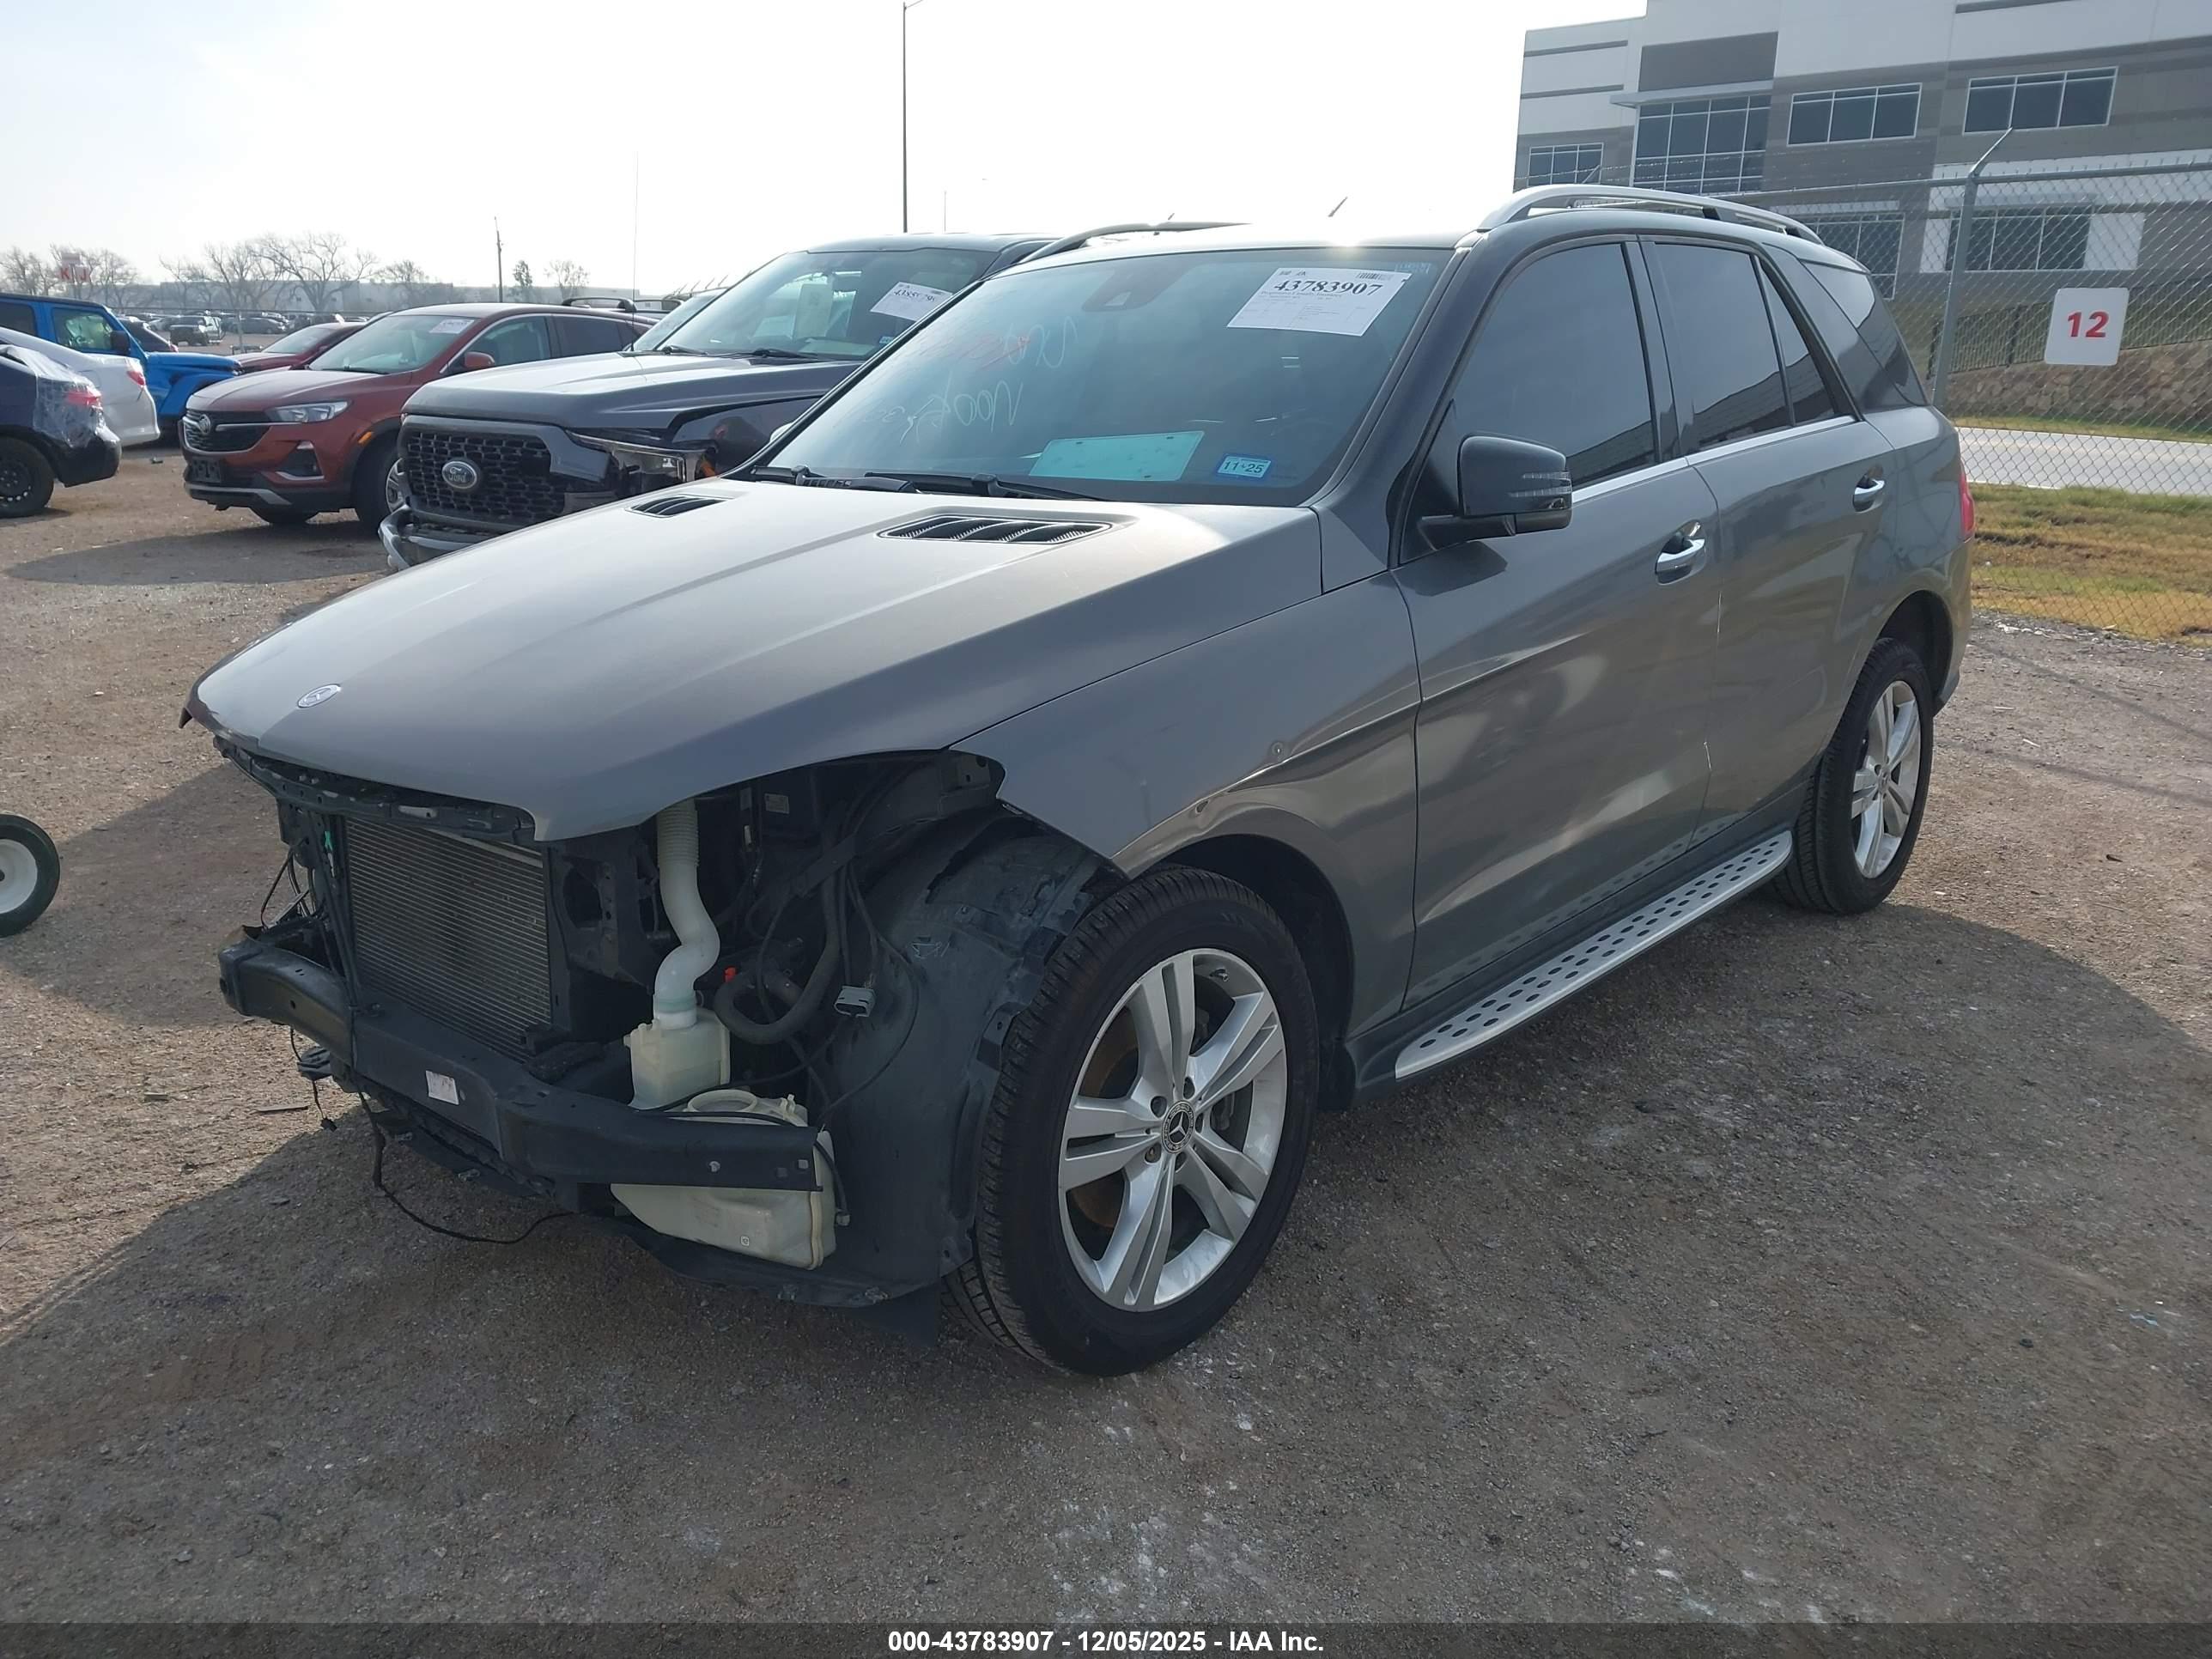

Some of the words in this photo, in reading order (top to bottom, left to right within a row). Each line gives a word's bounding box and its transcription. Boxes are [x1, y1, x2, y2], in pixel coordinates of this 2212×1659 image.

[1273, 279, 1383, 297] 43783907
[2067, 311, 2109, 337] 12
[447, 466, 467, 483] Ford
